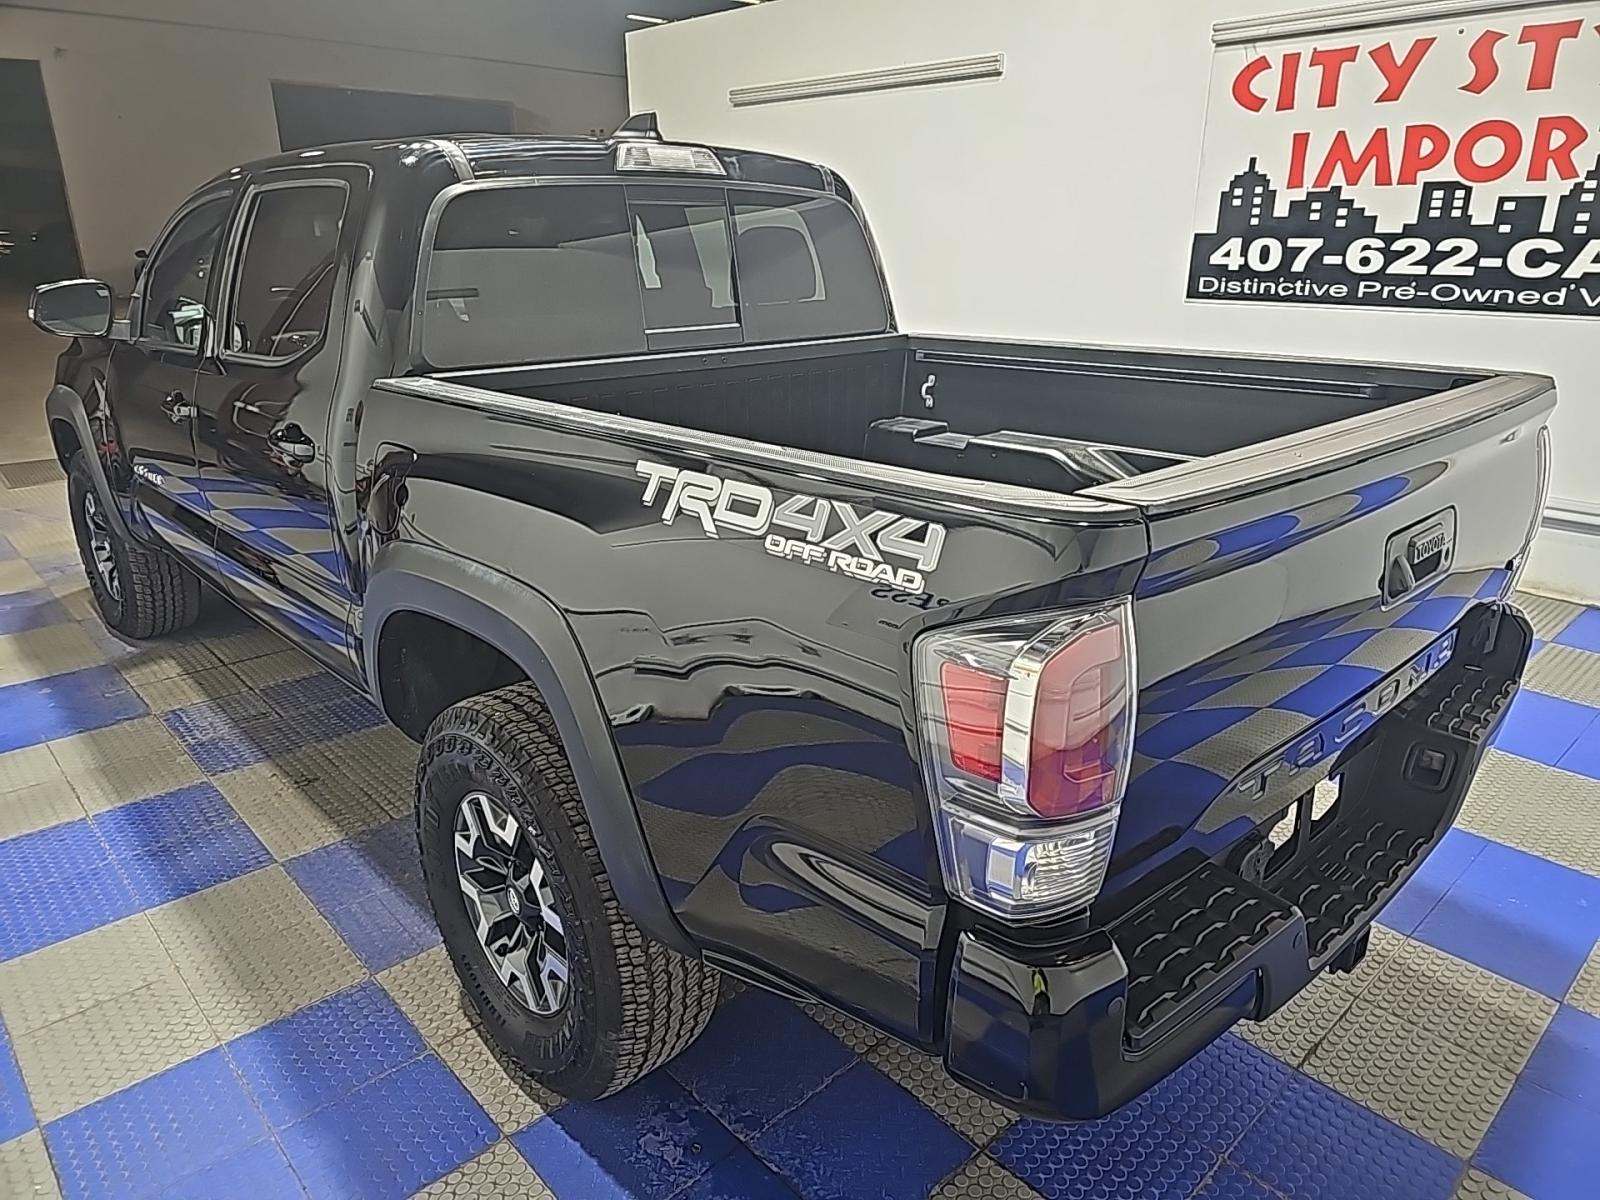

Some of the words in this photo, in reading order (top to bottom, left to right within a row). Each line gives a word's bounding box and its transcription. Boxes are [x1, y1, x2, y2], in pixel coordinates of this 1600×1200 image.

[1231, 36, 1438, 113] CITY
[1457, 18, 1600, 95] ST
[1286, 115, 1589, 190] IMPOR
[1197, 276, 1349, 298] Distinctive
[1357, 281, 1568, 306] Pre-Owned
[634, 459, 774, 540] TRD
[764, 533, 829, 565] OFF
[824, 551, 926, 596] ROAD
